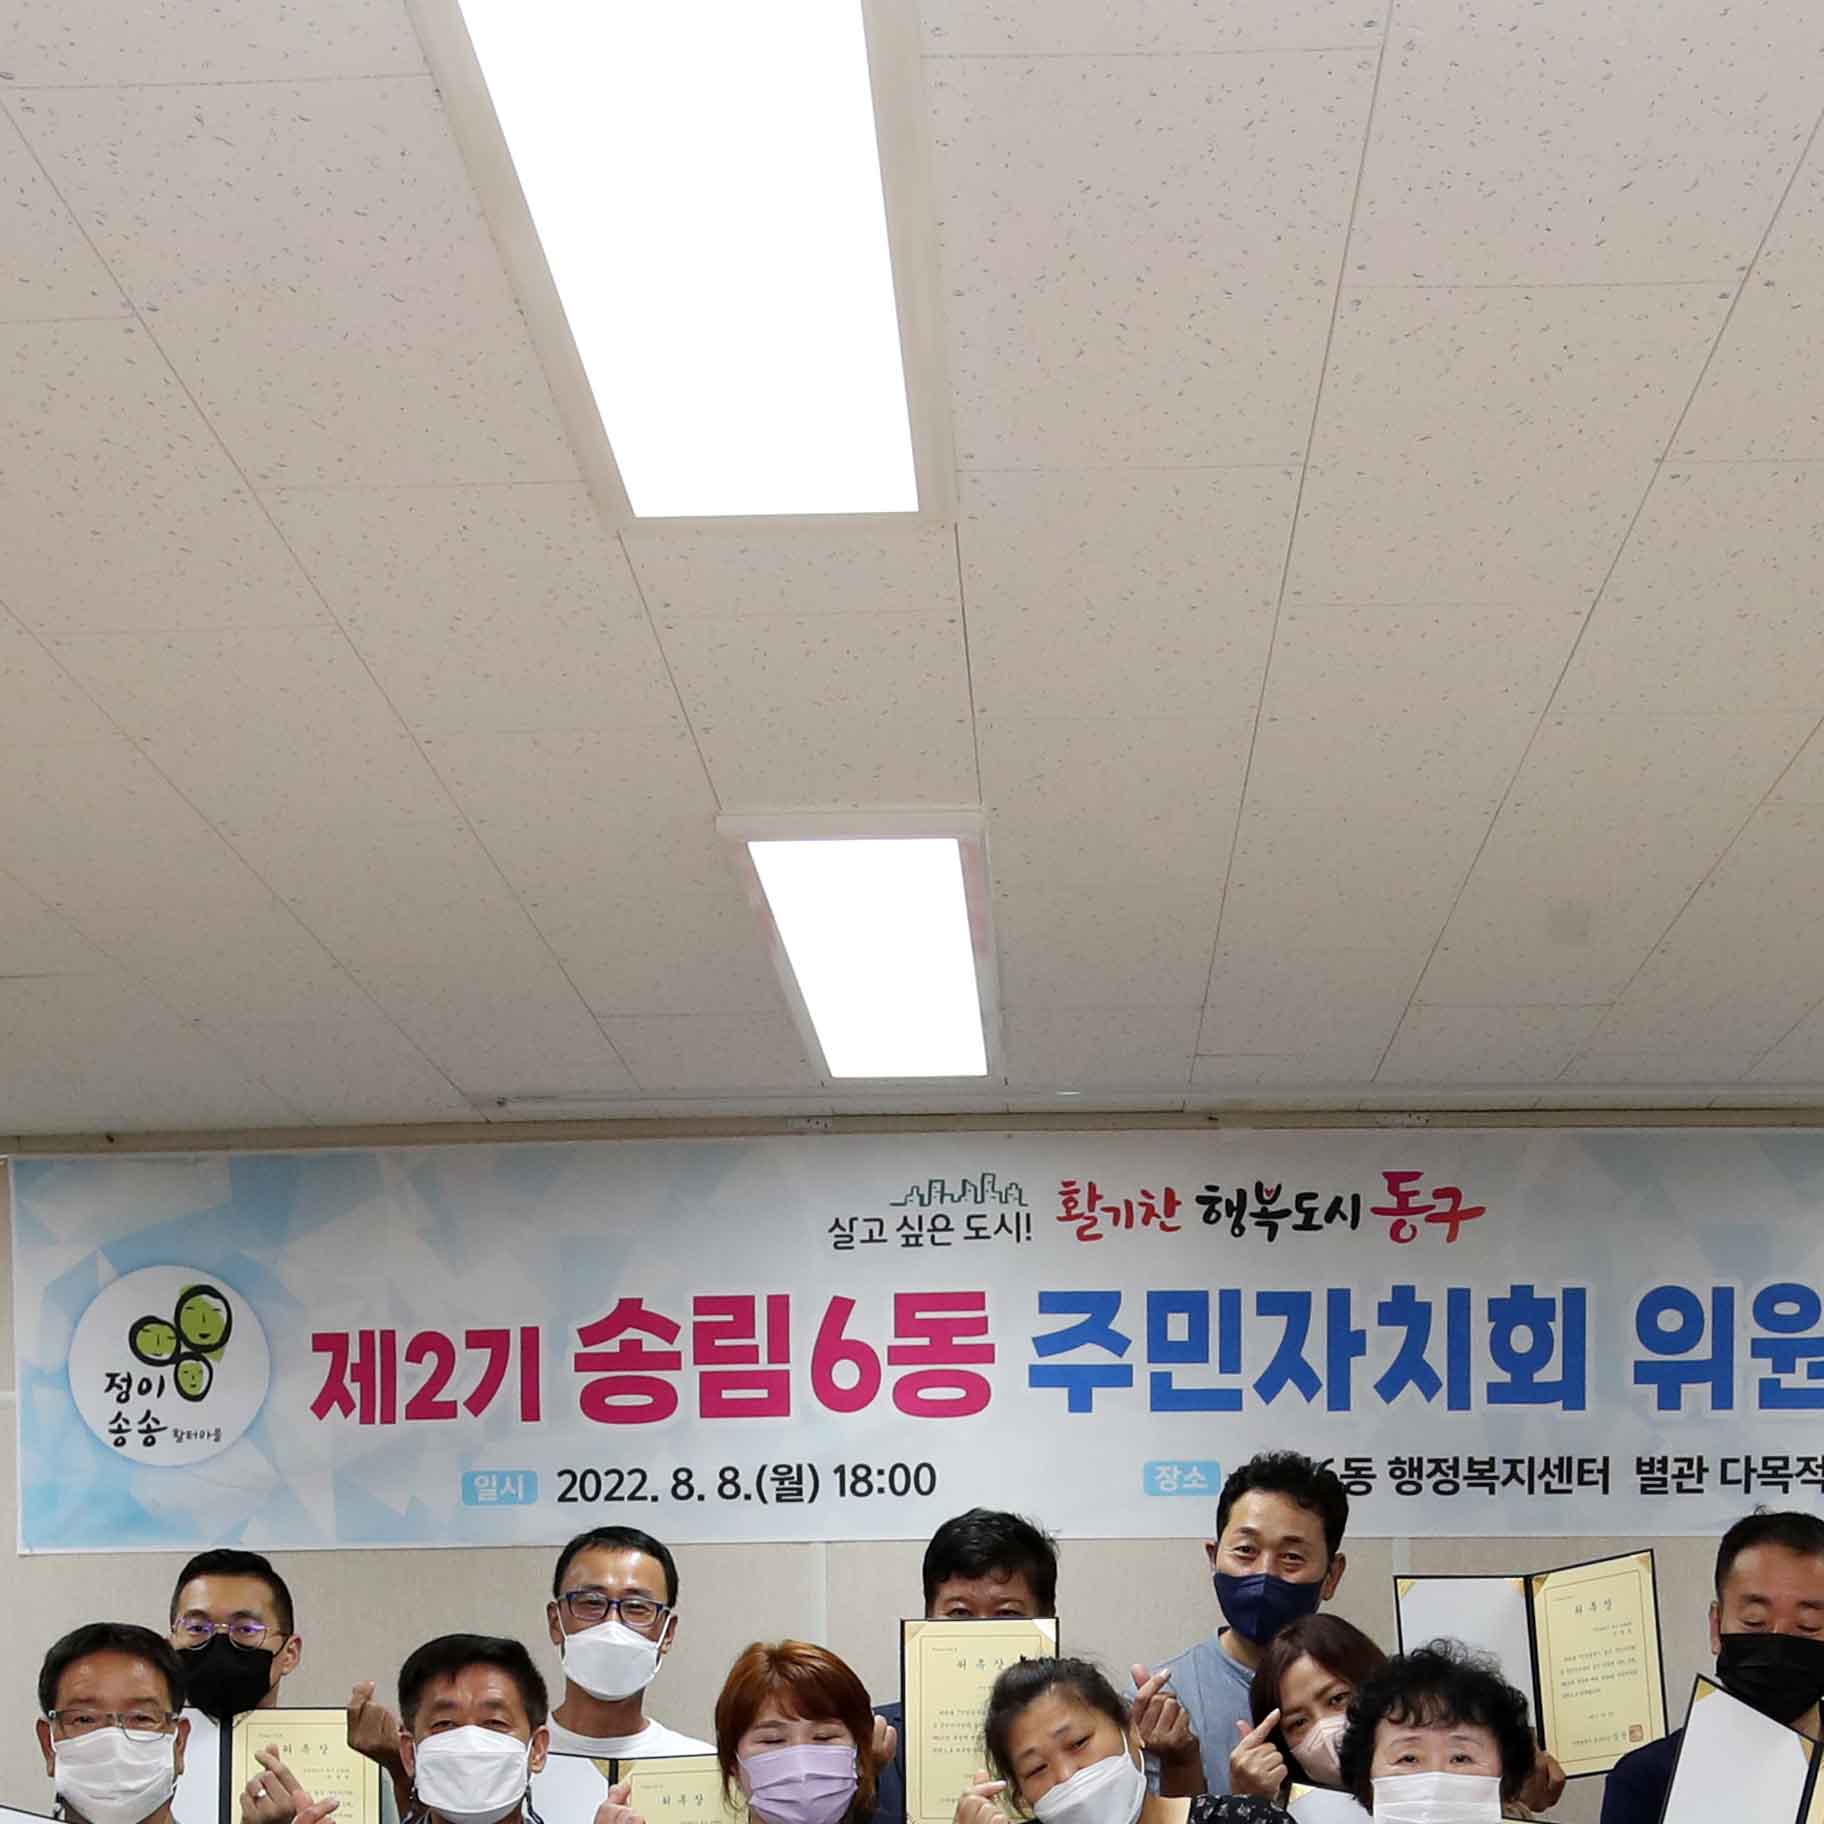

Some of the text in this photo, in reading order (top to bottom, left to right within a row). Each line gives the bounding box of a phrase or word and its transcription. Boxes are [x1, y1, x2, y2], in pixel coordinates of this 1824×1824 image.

[1057, 1171, 1486, 1243] 활기찬 행복도시 동구
[827, 1211, 1032, 1250] 살고 싶은 도시!
[310, 1325, 540, 1425] 제2기
[575, 1290, 996, 1425] 송림6동
[1028, 1285, 1587, 1414] 주민자치회
[104, 1371, 165, 1404] 정이
[108, 1409, 168, 1447] 송송
[474, 1462, 937, 1504] 일시 2022. 8. 8.(월) 18:00
[1154, 1465, 1208, 1492] 장소
[1387, 1455, 1610, 1497] 행정복지센터
[1635, 1455, 1710, 1495] 별관
